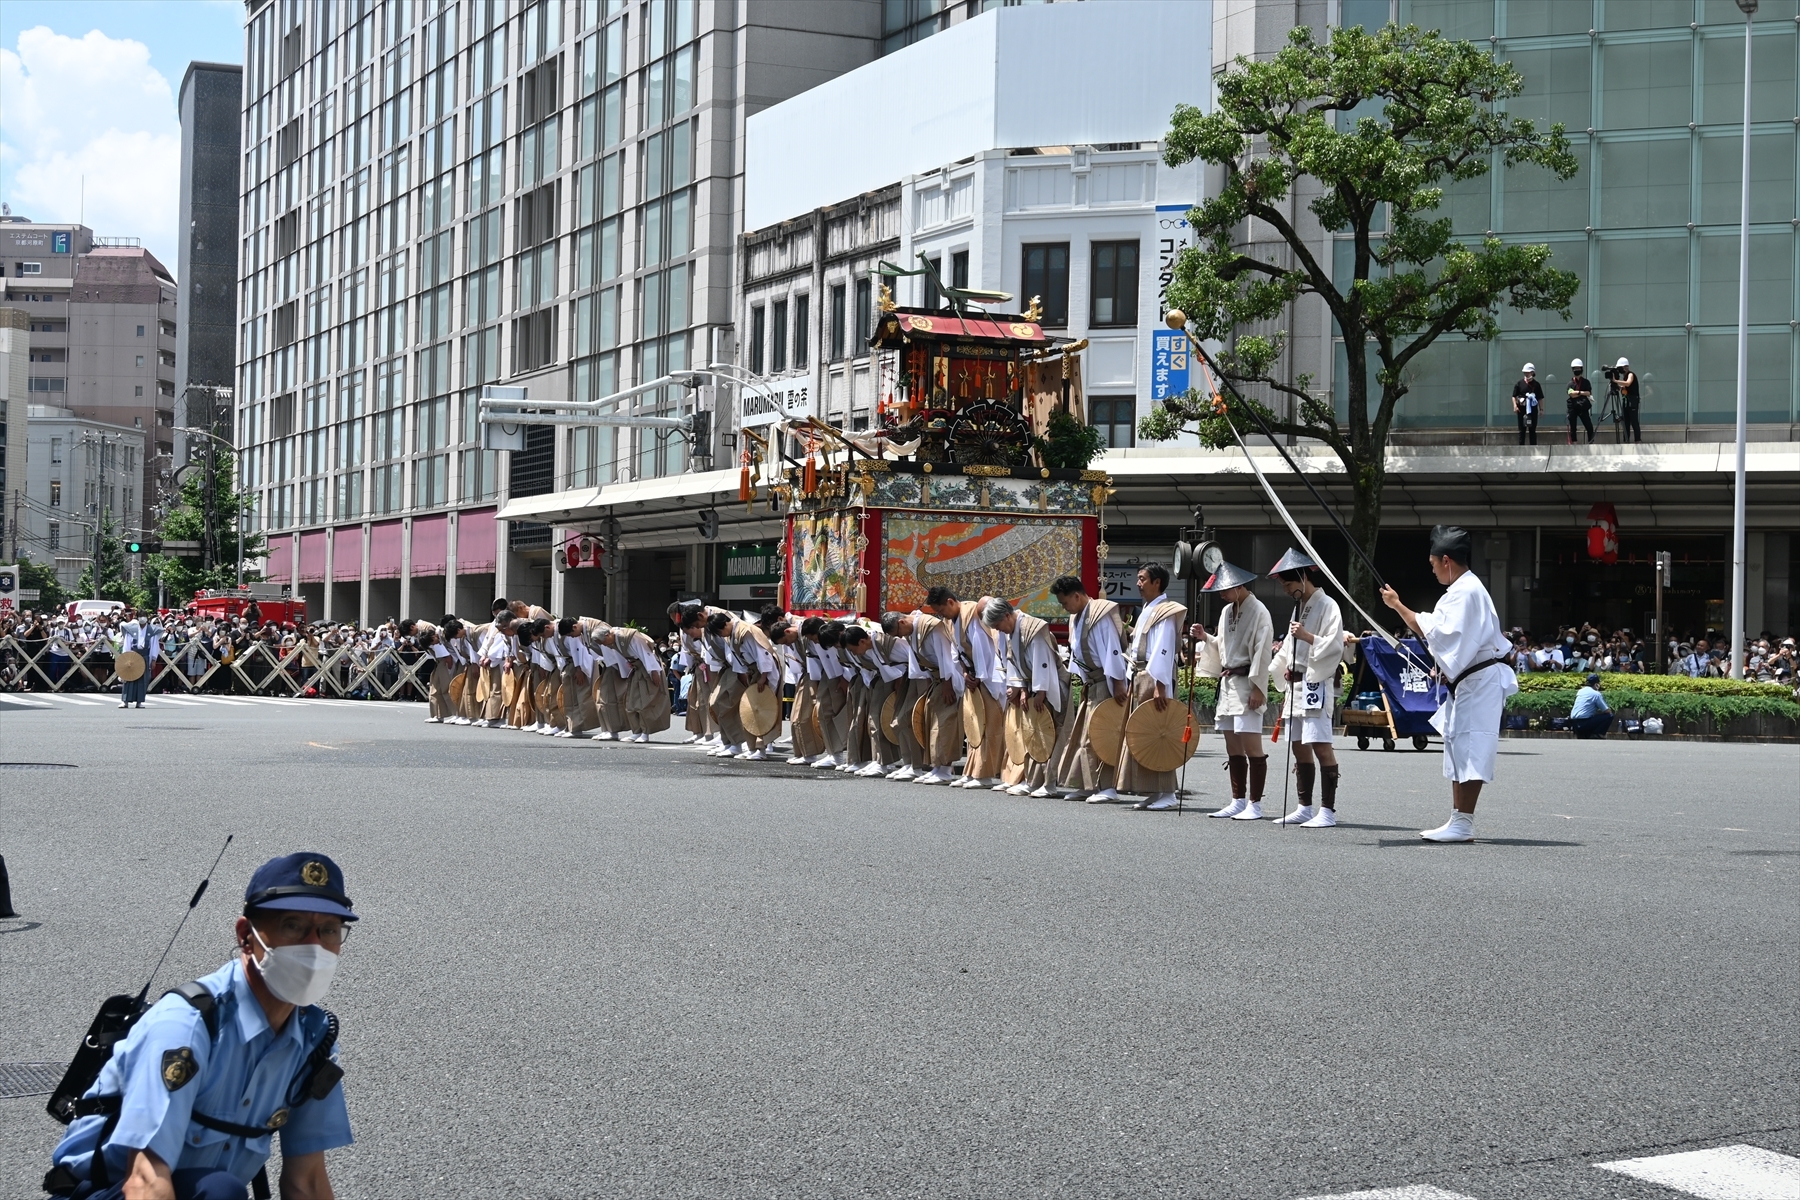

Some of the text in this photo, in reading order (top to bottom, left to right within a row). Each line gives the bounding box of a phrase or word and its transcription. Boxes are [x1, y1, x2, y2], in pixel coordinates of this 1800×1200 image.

[1156, 336, 1170, 398] 買えます
[1172, 338, 1185, 369] すぐ
[743, 387, 808, 417] MARUMARU 雲の茶
[727, 556, 766, 577] MARUMARU
[1647, 586, 1701, 596] Taashimaya
